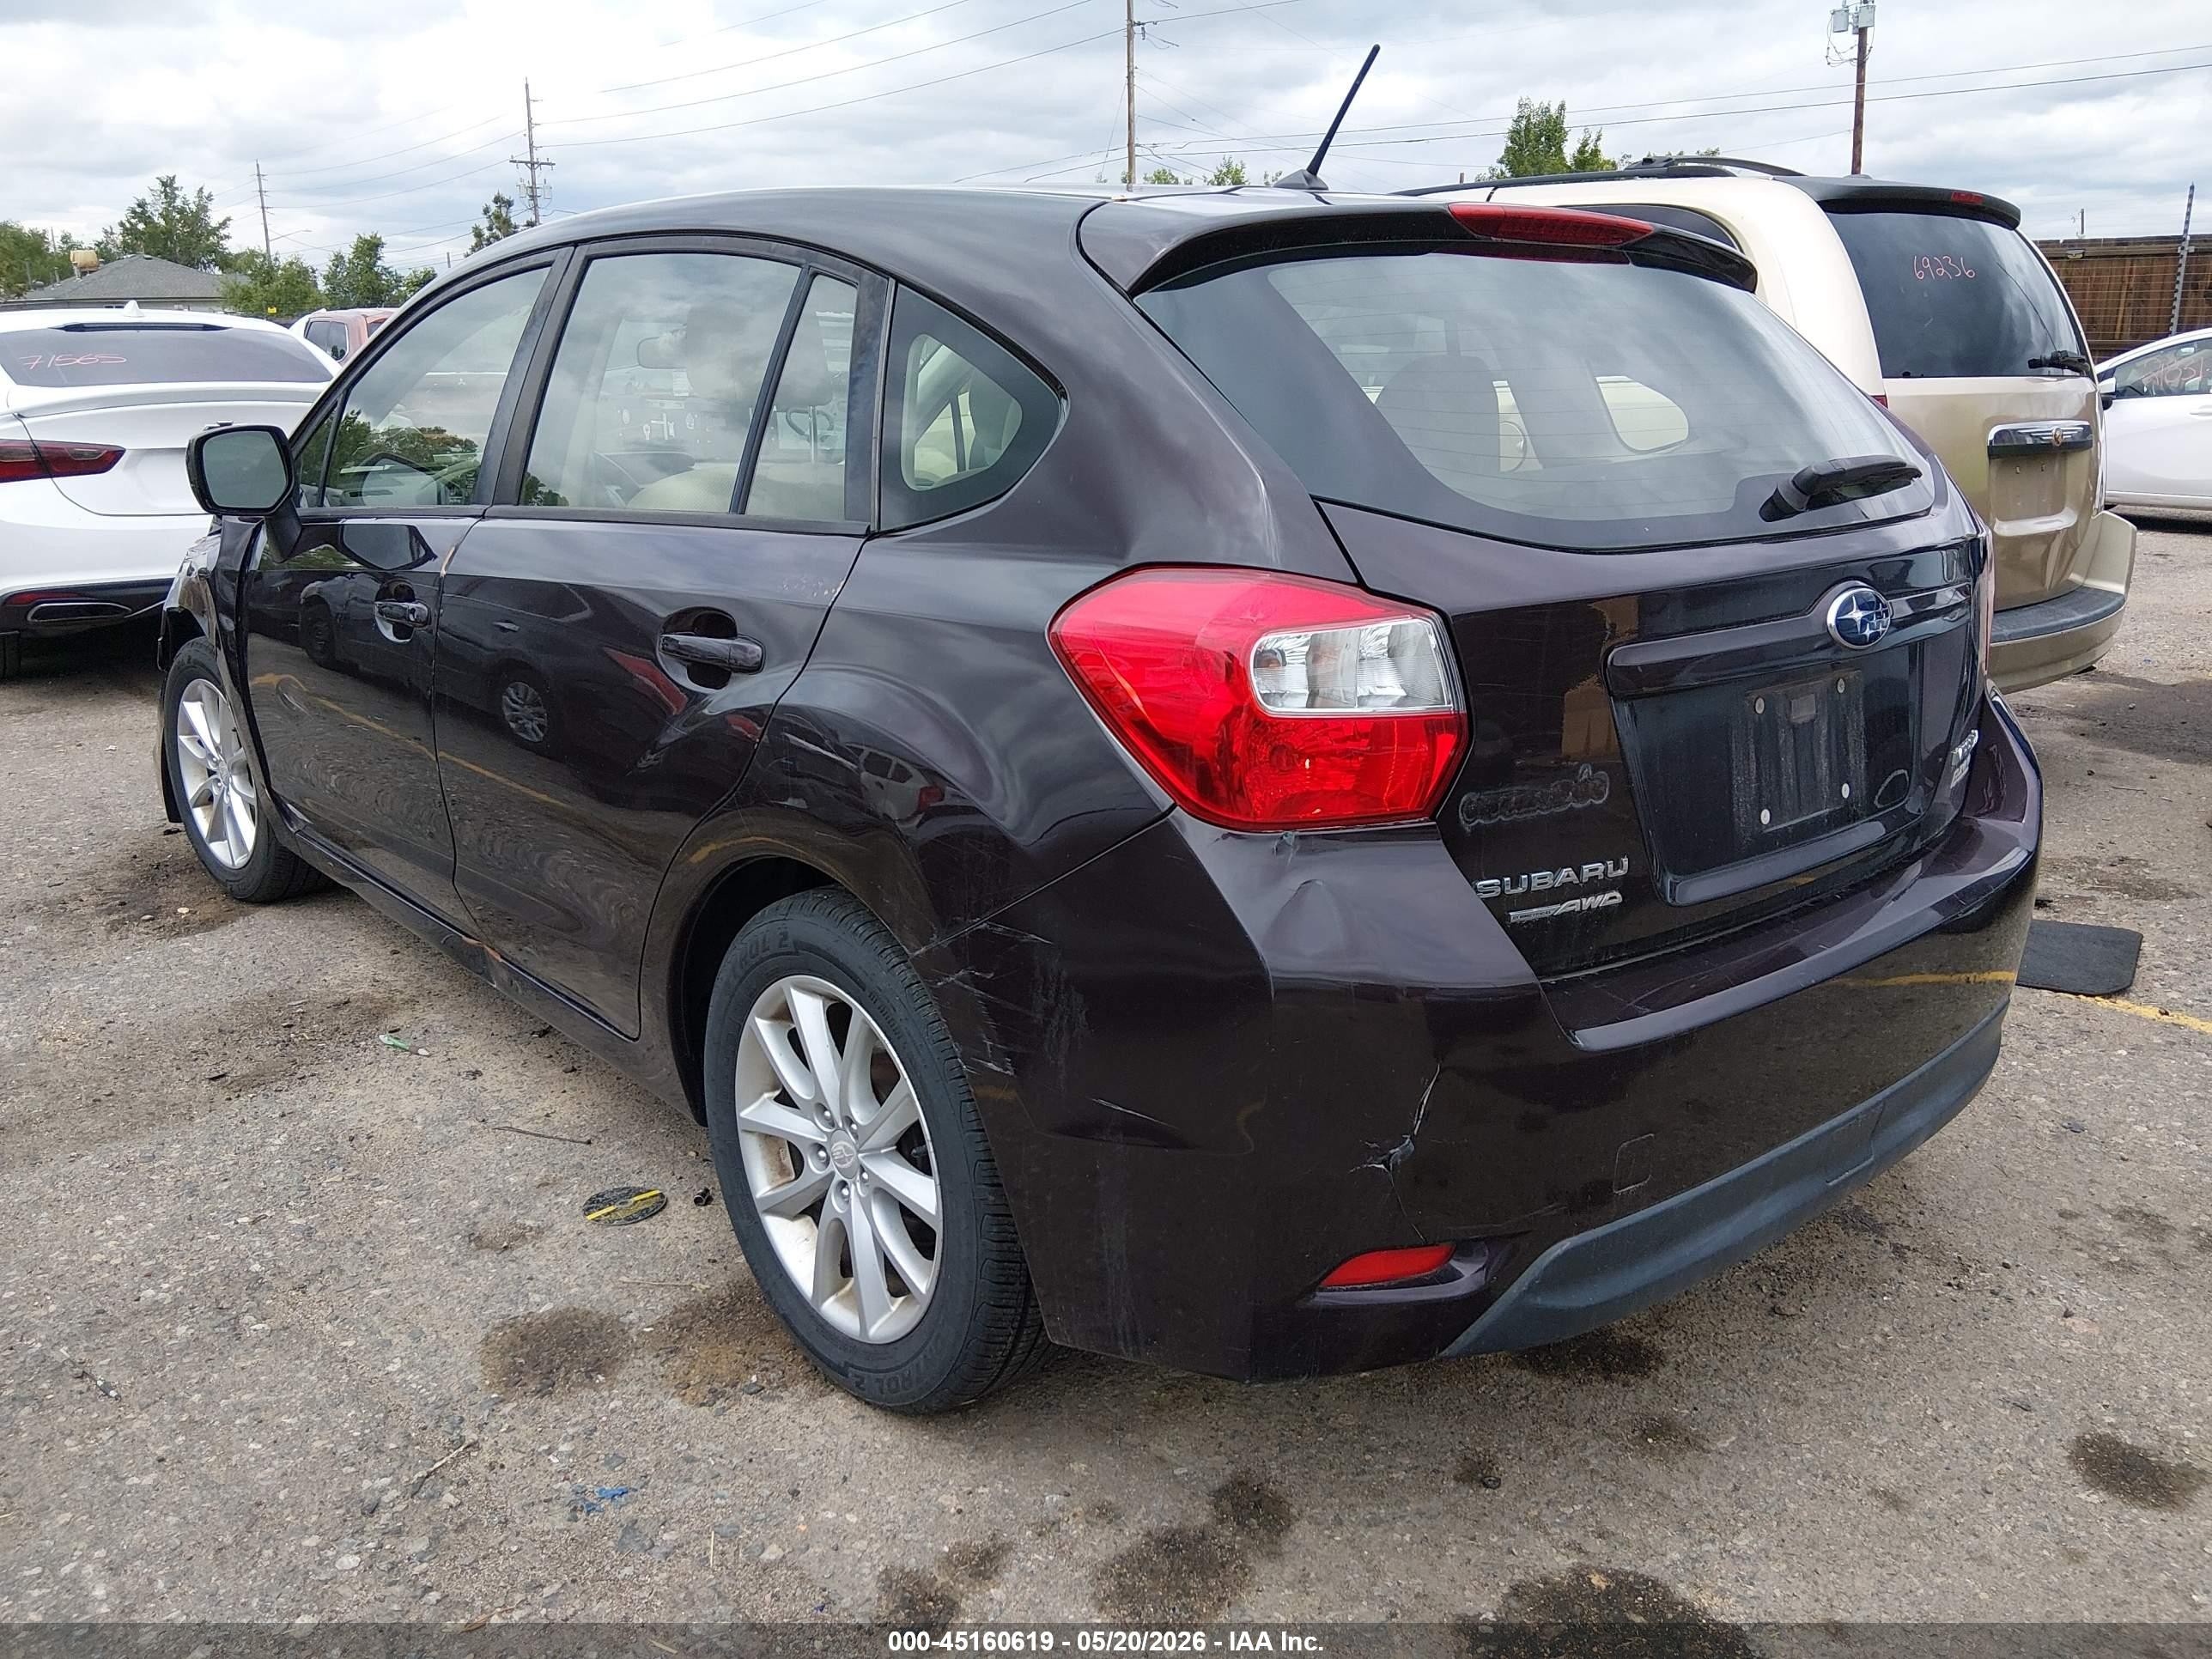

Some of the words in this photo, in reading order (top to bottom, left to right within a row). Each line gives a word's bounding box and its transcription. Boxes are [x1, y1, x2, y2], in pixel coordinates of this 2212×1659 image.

[1914, 255, 1976, 280] 69236
[18, 353, 127, 369] 71565
[1475, 855, 1630, 899] SUBARU
[1553, 890, 1624, 915] AWD
